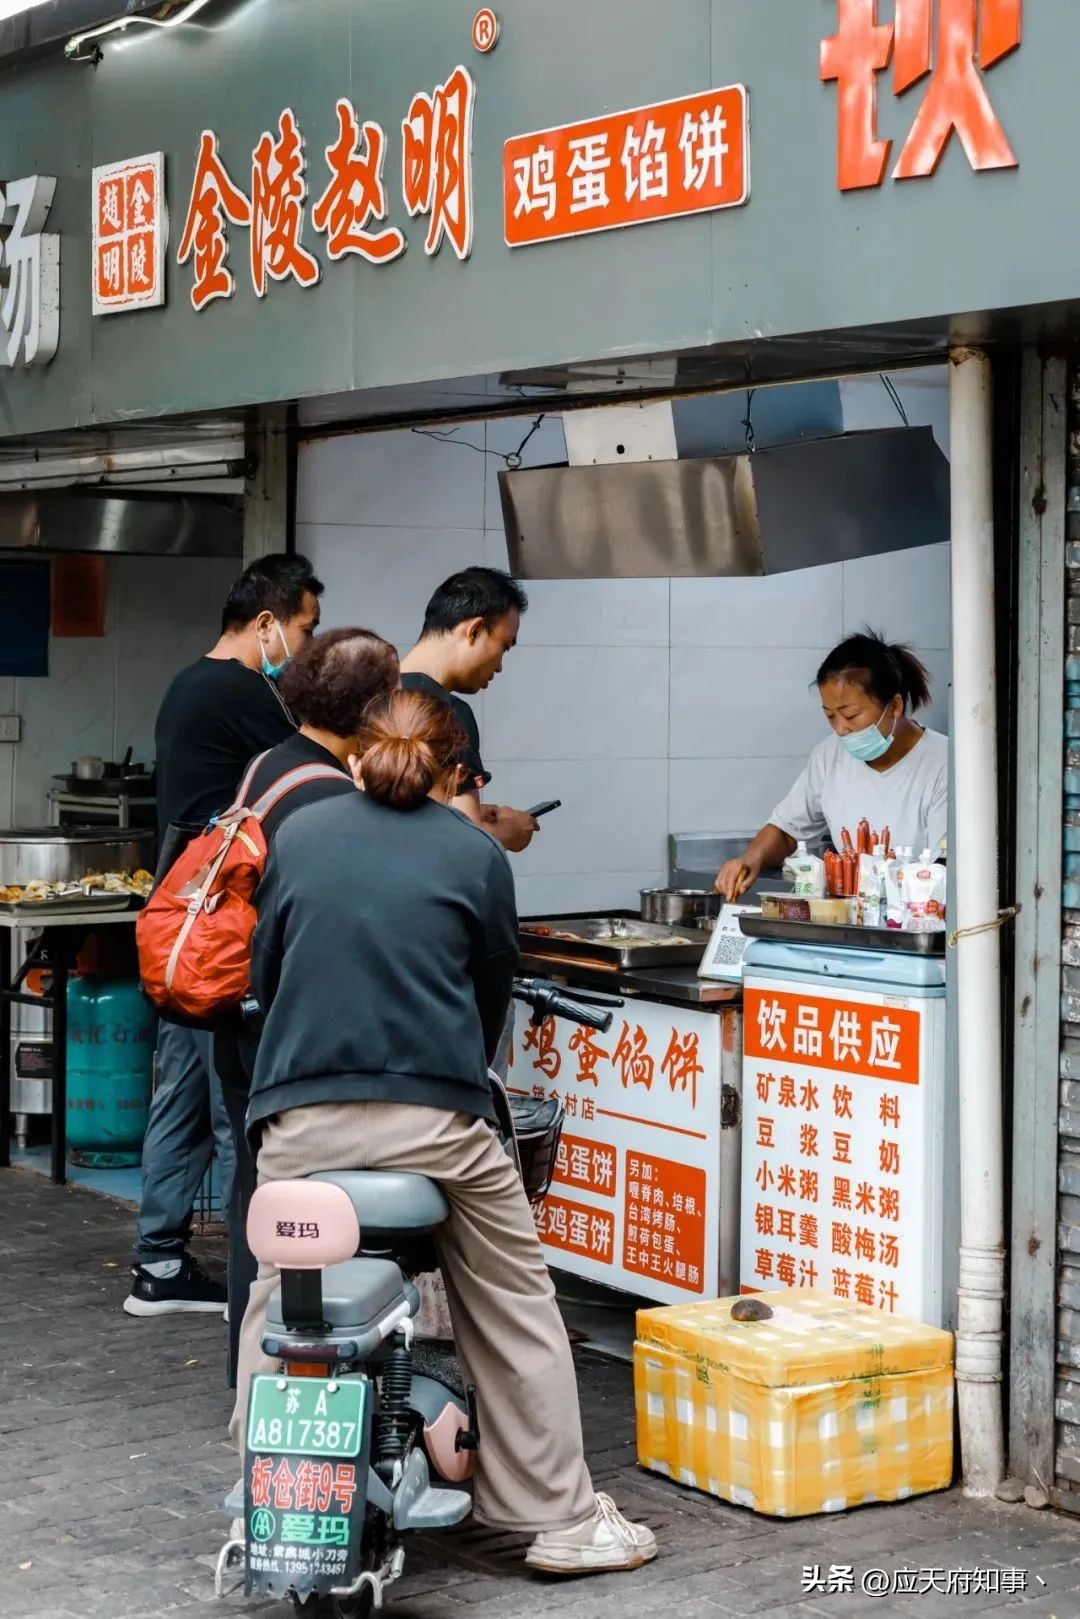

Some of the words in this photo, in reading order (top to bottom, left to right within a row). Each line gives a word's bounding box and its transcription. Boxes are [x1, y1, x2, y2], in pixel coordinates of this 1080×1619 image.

[177, 65, 475, 311] 金陵赵明
[512, 104, 729, 221] 鸡蛋馅饼
[757, 999, 902, 1070] 饮品供应
[756, 1073, 819, 1112] 矿泉水
[833, 1084, 900, 1128] 饮料
[757, 1116, 818, 1157] 豆浆
[833, 1131, 900, 1175] 豆奶
[628, 1202, 681, 1234] 台湾烤肠、
[755, 1160, 819, 1203] 小米粥
[832, 1176, 900, 1222] 黑米粥
[276, 1221, 320, 1239] 爱玛
[755, 1203, 819, 1249] 银耳羹
[832, 1221, 900, 1268] 酸梅汤
[626, 1245, 699, 1285] 王中王火腿肠
[754, 1248, 819, 1288] 草莓汁
[832, 1267, 900, 1314] 蓝莓汁
[314, 1389, 328, 1416] A
[253, 1418, 356, 1450] A817387
[251, 1456, 357, 1513] 板仓街9号
[281, 1514, 350, 1545] 爱玛
